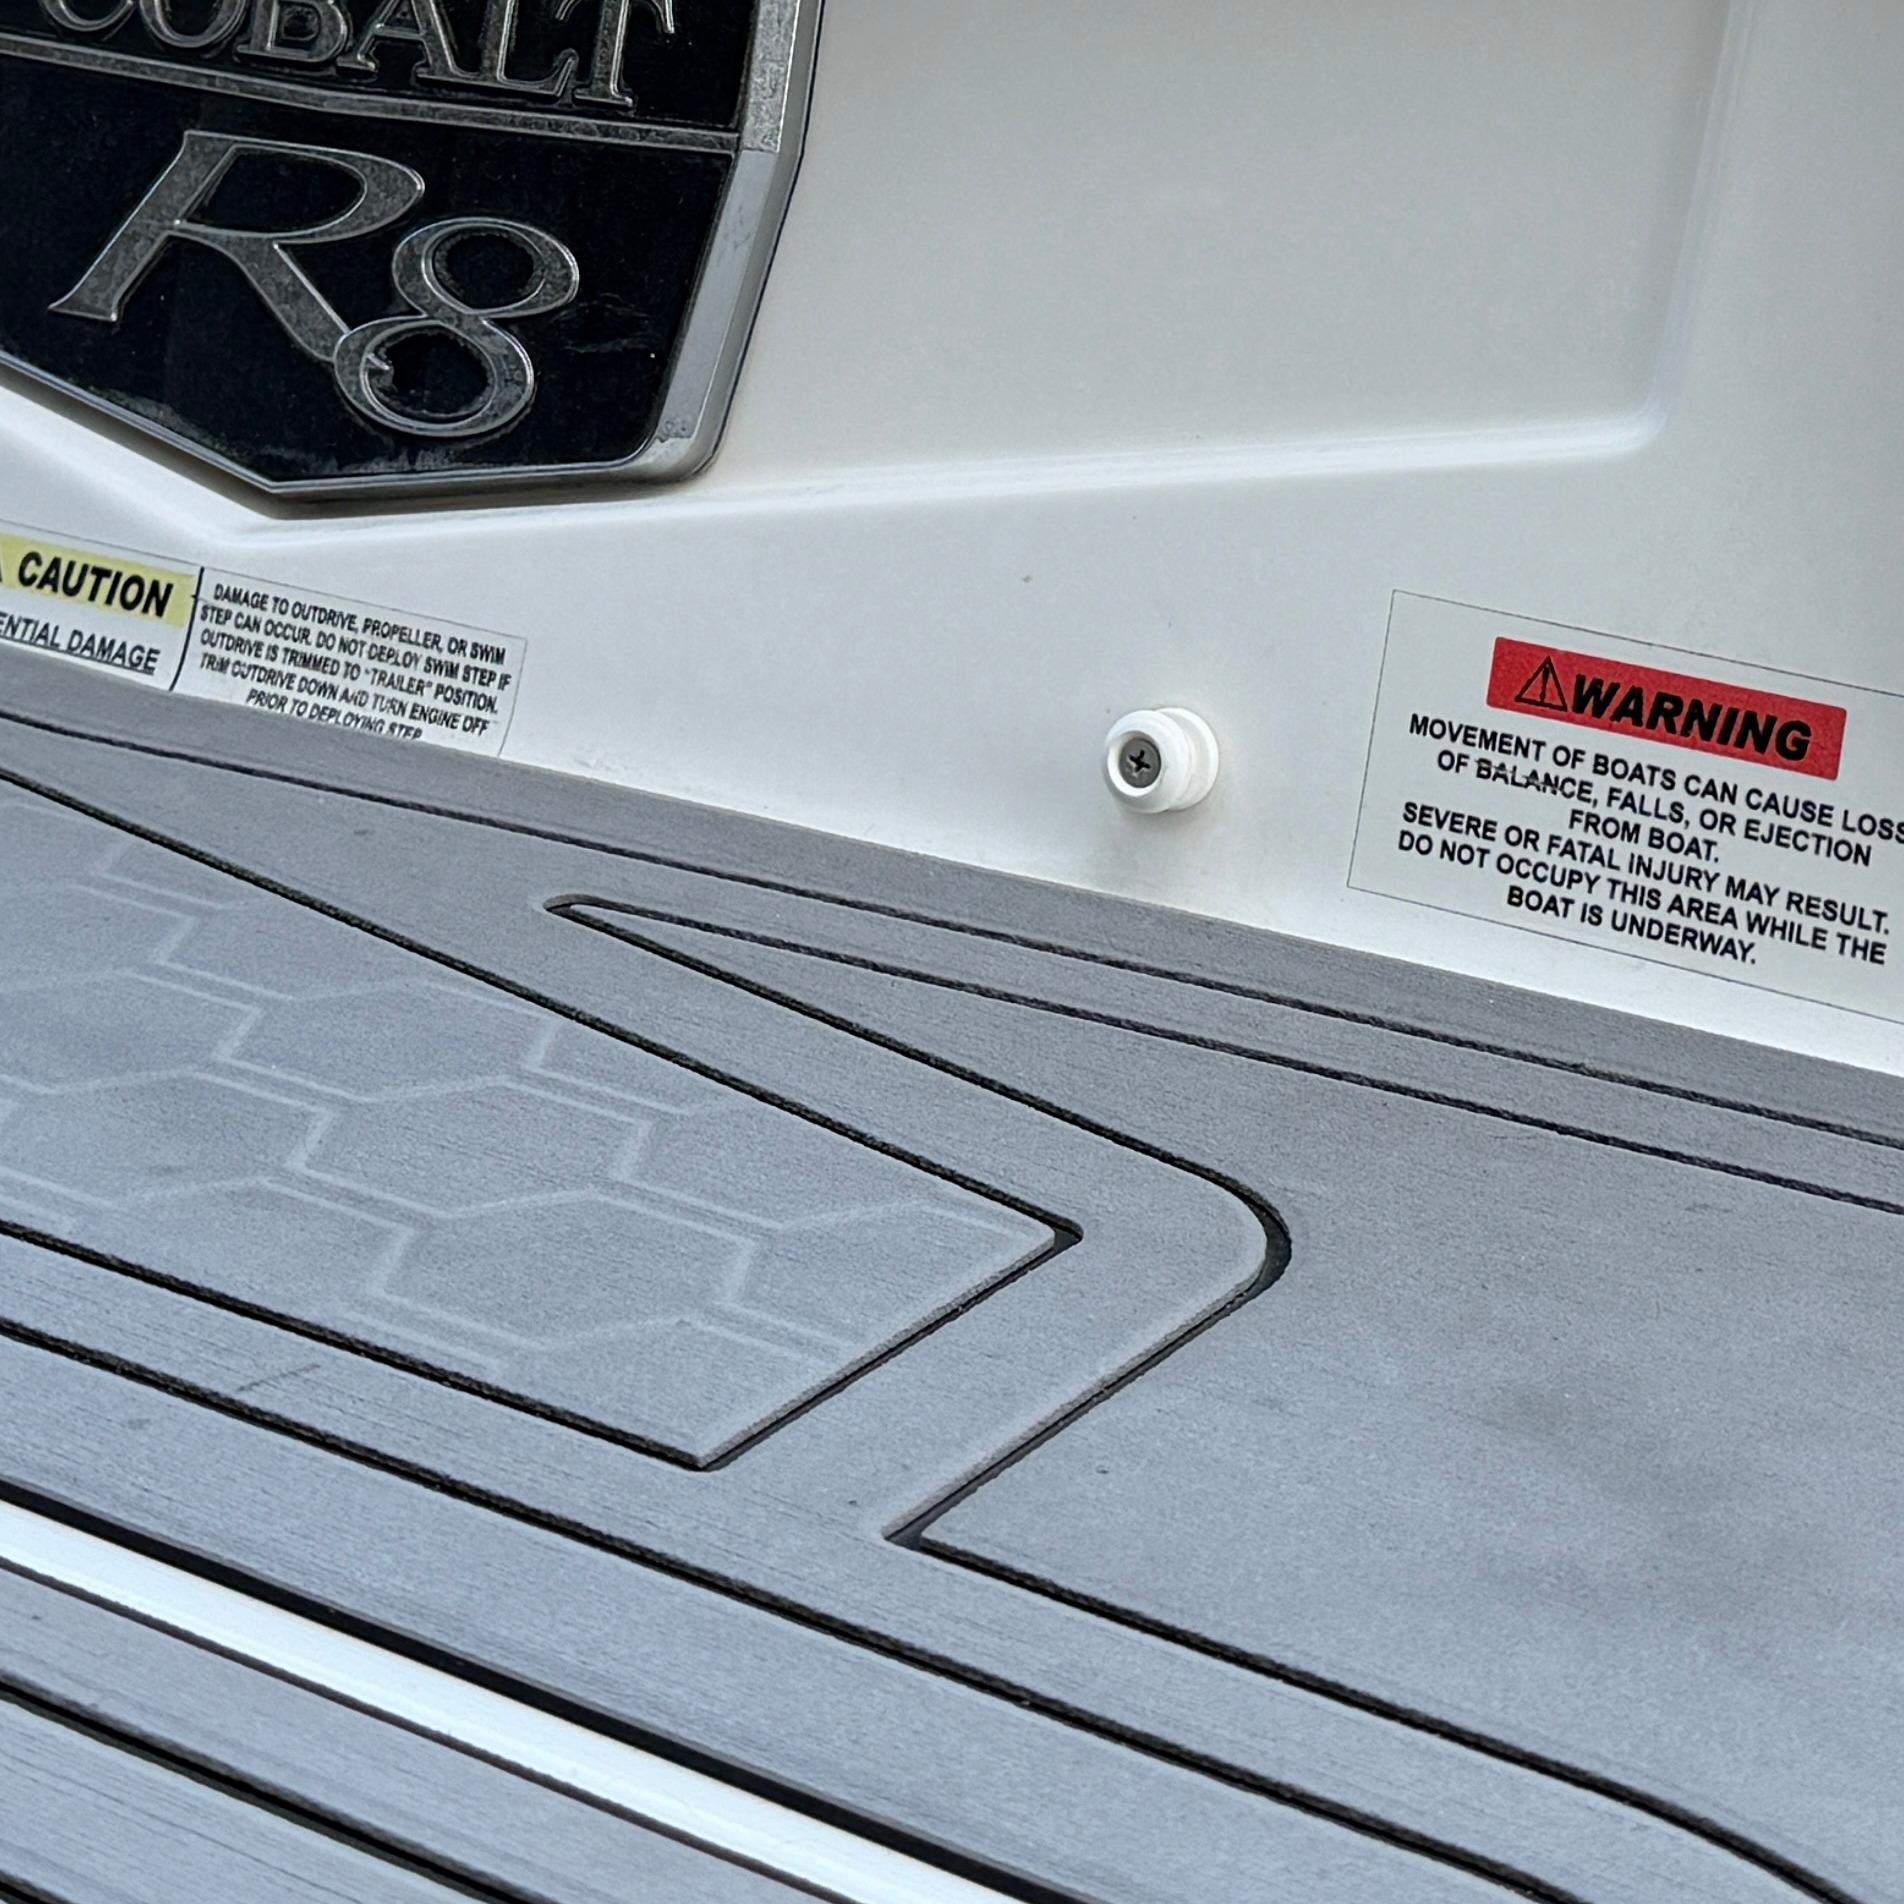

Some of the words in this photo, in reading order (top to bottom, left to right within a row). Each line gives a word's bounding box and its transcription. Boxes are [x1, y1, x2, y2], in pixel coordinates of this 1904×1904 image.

[47, 130, 580, 438] R8
[18, 551, 174, 618] CAUTION
[214, 583, 269, 611] DAMAGE
[272, 596, 289, 615] TO
[447, 637, 466, 657] OR
[470, 642, 506, 665] SWIM
[66, 630, 160, 671] DAMAGE
[200, 604, 233, 626] STEP
[234, 612, 262, 634] CAN
[315, 631, 336, 651] DO
[338, 635, 365, 658] NOT
[368, 643, 422, 671] DEPLOY
[424, 656, 460, 679] SWIM
[462, 665, 496, 687] STEP
[497, 674, 512, 691] IF
[201, 628, 264, 659] OUTDRIVE
[265, 643, 279, 662] IS
[281, 647, 340, 676] TRIMMED
[342, 661, 361, 681] TO
[200, 653, 231, 674] TRIM
[231, 660, 296, 691] OUTDRIVE
[297, 676, 339, 701] DOWN
[340, 687, 369, 708] AND
[372, 693, 409, 717] TURN
[409, 703, 461, 730] ENGINE
[462, 718, 490, 737] OFF
[247, 689, 288, 713] PRIOR
[290, 700, 308, 717] TO
[309, 703, 385, 733] DEPLOYING
[1570, 673, 1812, 762] WARNING
[1409, 713, 1546, 762] MOVEMENT
[1552, 745, 1586, 770] OF
[1592, 753, 1676, 791] BOATS
[1684, 774, 1737, 805] CAN
[1745, 788, 1835, 827] CAUSE
[1437, 750, 1470, 774] OF
[1476, 758, 1598, 808] BALANCE,
[1607, 787, 1690, 829] FALLS,
[1700, 809, 1737, 836] OR
[1744, 819, 1872, 867] EJECTION
[1403, 801, 1498, 842] SEVERE
[1505, 825, 1540, 852] OR
[1547, 835, 1621, 871] FATAL
[1628, 852, 1720, 892] INJURY
[1725, 876, 1780, 907] MAY
[1785, 891, 1889, 935] RESULT.
[1569, 809, 1641, 845] FROM
[1648, 827, 1719, 863] BOAT.
[1398, 830, 1433, 856] DO
[1440, 840, 1490, 868] NOT
[1496, 853, 1601, 894] OCCUPY
[1607, 878, 1661, 911] THIS
[1667, 895, 1738, 930] AREA
[1746, 911, 1828, 950] WHILE
[1836, 933, 1887, 965] THE
[1507, 886, 1574, 918] BOAT
[1580, 902, 1603, 926] IS
[1611, 910, 1756, 964] UNDERWAY.
